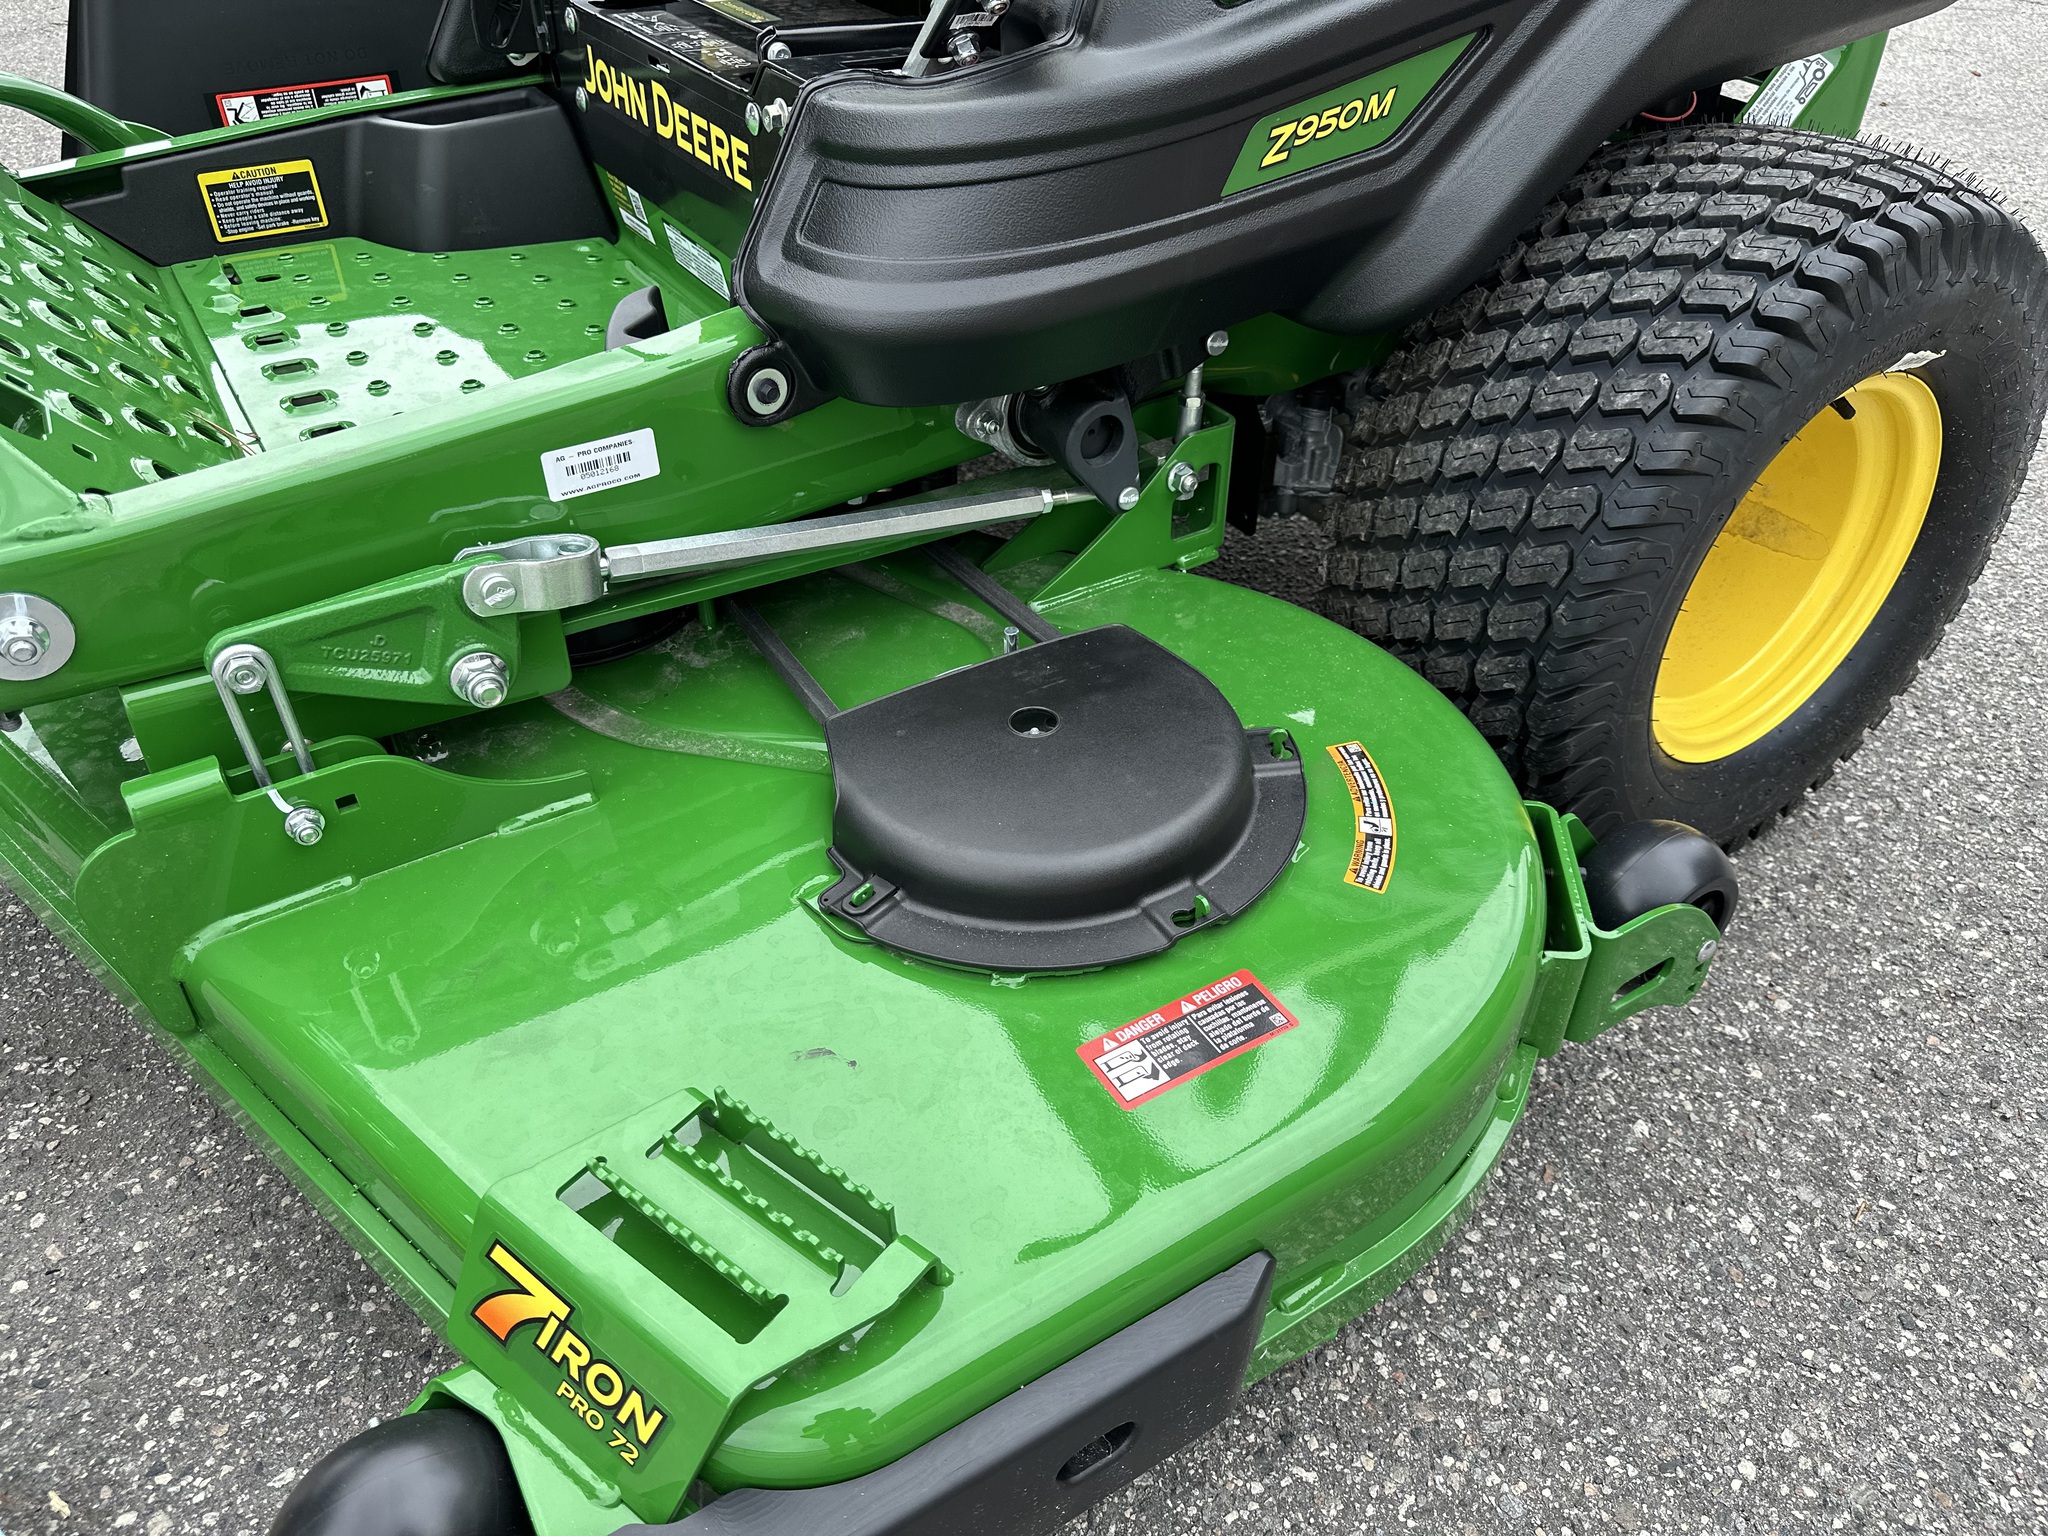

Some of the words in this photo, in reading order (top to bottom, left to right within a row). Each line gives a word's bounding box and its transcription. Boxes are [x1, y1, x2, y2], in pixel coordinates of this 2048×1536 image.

[585, 44, 649, 127] JOHN
[651, 80, 752, 192] DEERE
[1259, 86, 1398, 170] Z950M
[239, 166, 277, 178] CAUTION
[244, 178, 262, 186] AVOID
[262, 175, 284, 184] INJURY
[212, 188, 236, 197] Operator
[235, 185, 256, 194] training
[255, 182, 278, 191] required
[235, 214, 253, 222] people
[269, 209, 290, 217] distance
[555, 455, 566, 463] AG
[577, 449, 592, 458] PRO
[593, 439, 633, 454] COMPANIES
[561, 472, 641, 497] WWW.AGPROCO.COM
[580, 464, 620, 480] 05012168
[1337, 760, 1359, 797] ADVERTENCIA
[1353, 839, 1365, 866] WARNING
[1191, 975, 1243, 1006] PELIGRO
[1190, 1008, 1207, 1020] Para
[1204, 1000, 1225, 1013] evitar
[1221, 988, 1249, 1005] lesiones
[1196, 1008, 1227, 1027] causadas
[1223, 1003, 1238, 1013] por
[1234, 998, 1246, 1007] las
[1201, 1014, 1233, 1033] cuchillas,
[1230, 997, 1267, 1019] mantenerse
[1114, 1011, 1166, 1042] DANGER
[1139, 1035, 1152, 1045] To
[1148, 1026, 1170, 1040] avoid
[1167, 1017, 1190, 1032] injury
[1206, 1022, 1234, 1039] alejado
[1230, 1017, 1244, 1027] del
[1240, 1008, 1261, 1021] borde
[1258, 1004, 1270, 1012] de
[1219, 1020, 1255, 1041] plataforma
[1144, 1038, 1163, 1051] from
[1160, 1025, 1190, 1044] rotating
[1149, 1040, 1178, 1058] blades,
[1174, 1033, 1193, 1046] stay
[1155, 1050, 1176, 1064] clear
[1180, 1038, 1200, 1051] deck
[1218, 1041, 1230, 1051] de
[1226, 1033, 1248, 1046] corte.
[1161, 1055, 1184, 1071] edge.
[470, 1238, 575, 1347] 7
[532, 1310, 668, 1447] IRON
[556, 1380, 605, 1431] PRO
[608, 1429, 640, 1466] 72
